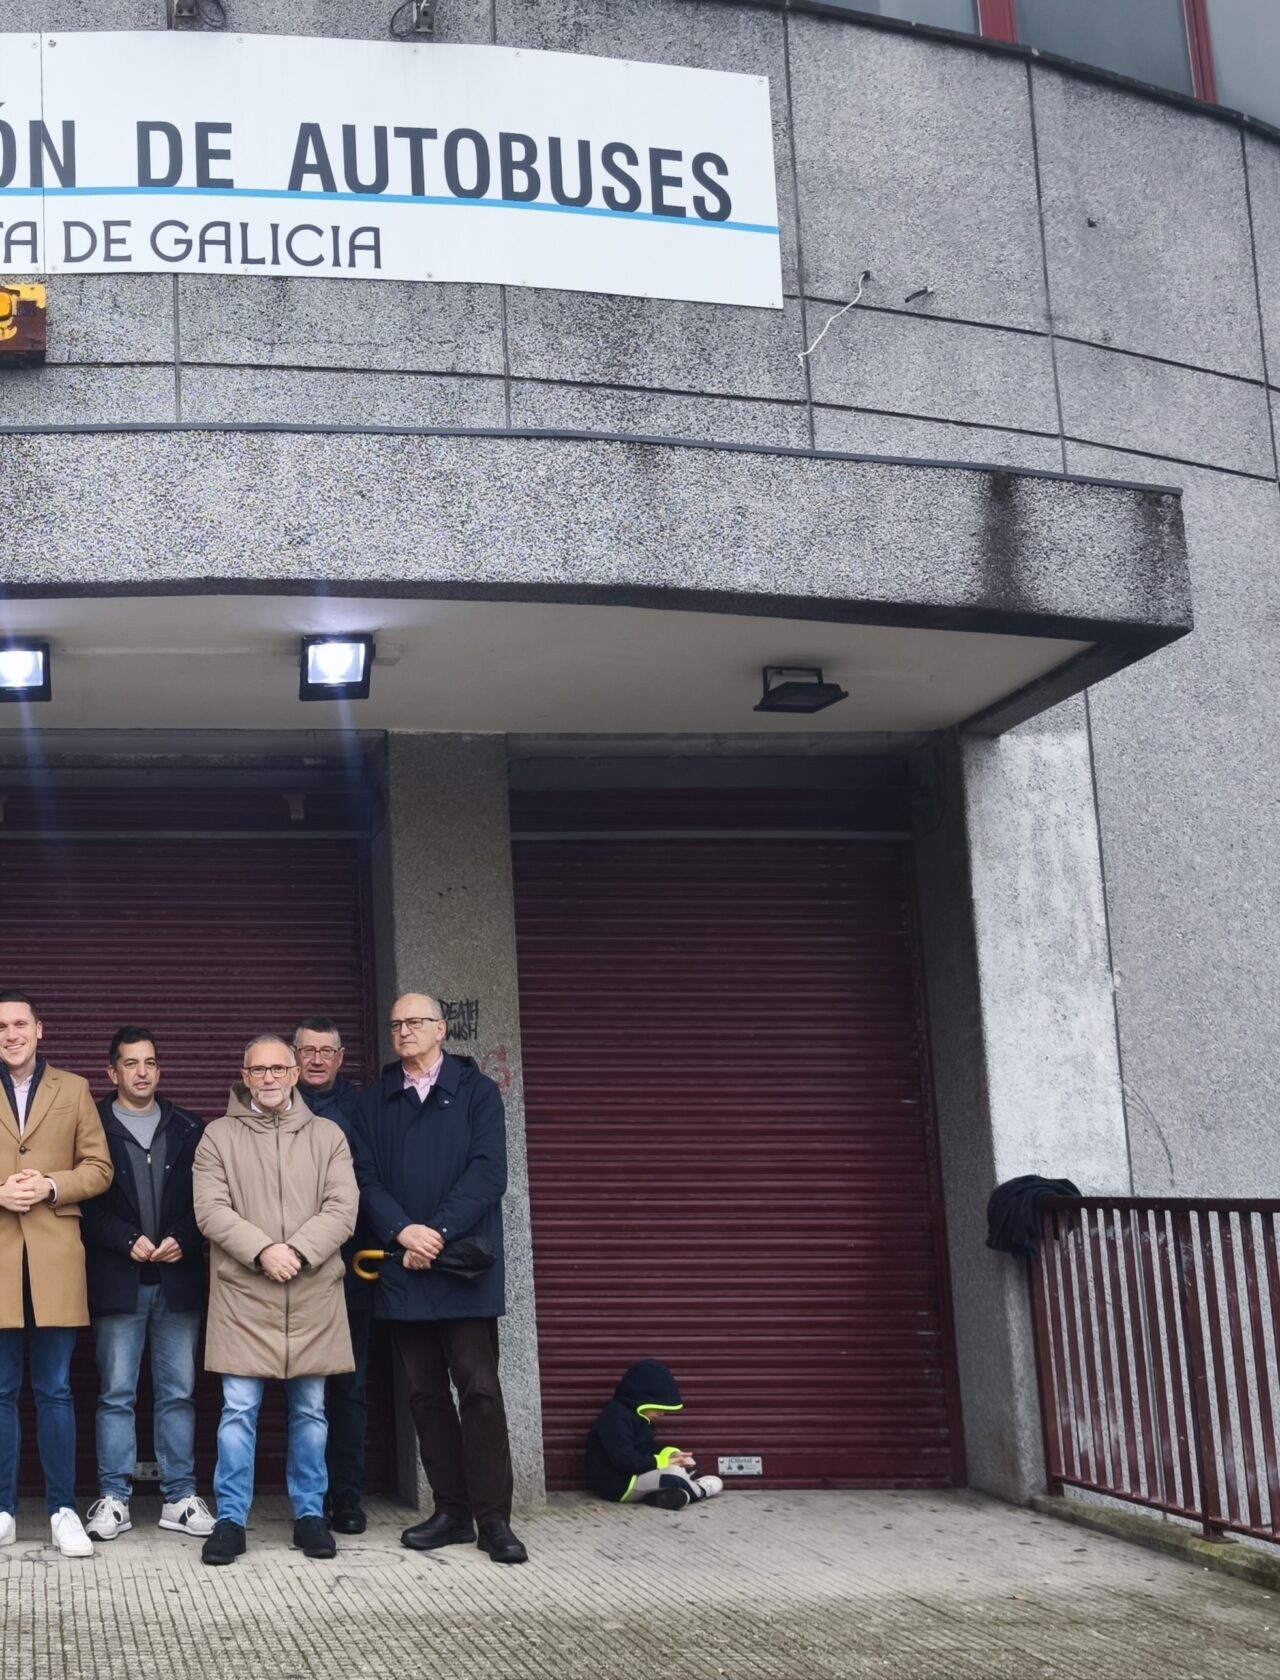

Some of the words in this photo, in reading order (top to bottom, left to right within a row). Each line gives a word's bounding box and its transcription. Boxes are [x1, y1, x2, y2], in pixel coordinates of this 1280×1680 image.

[136, 121, 234, 190] DE
[287, 122, 732, 223] AUTOBUSES
[63, 220, 132, 263] DE
[150, 219, 382, 269] GALICIA
[438, 998, 479, 1021] DEATH
[445, 1021, 478, 1041] WISH
